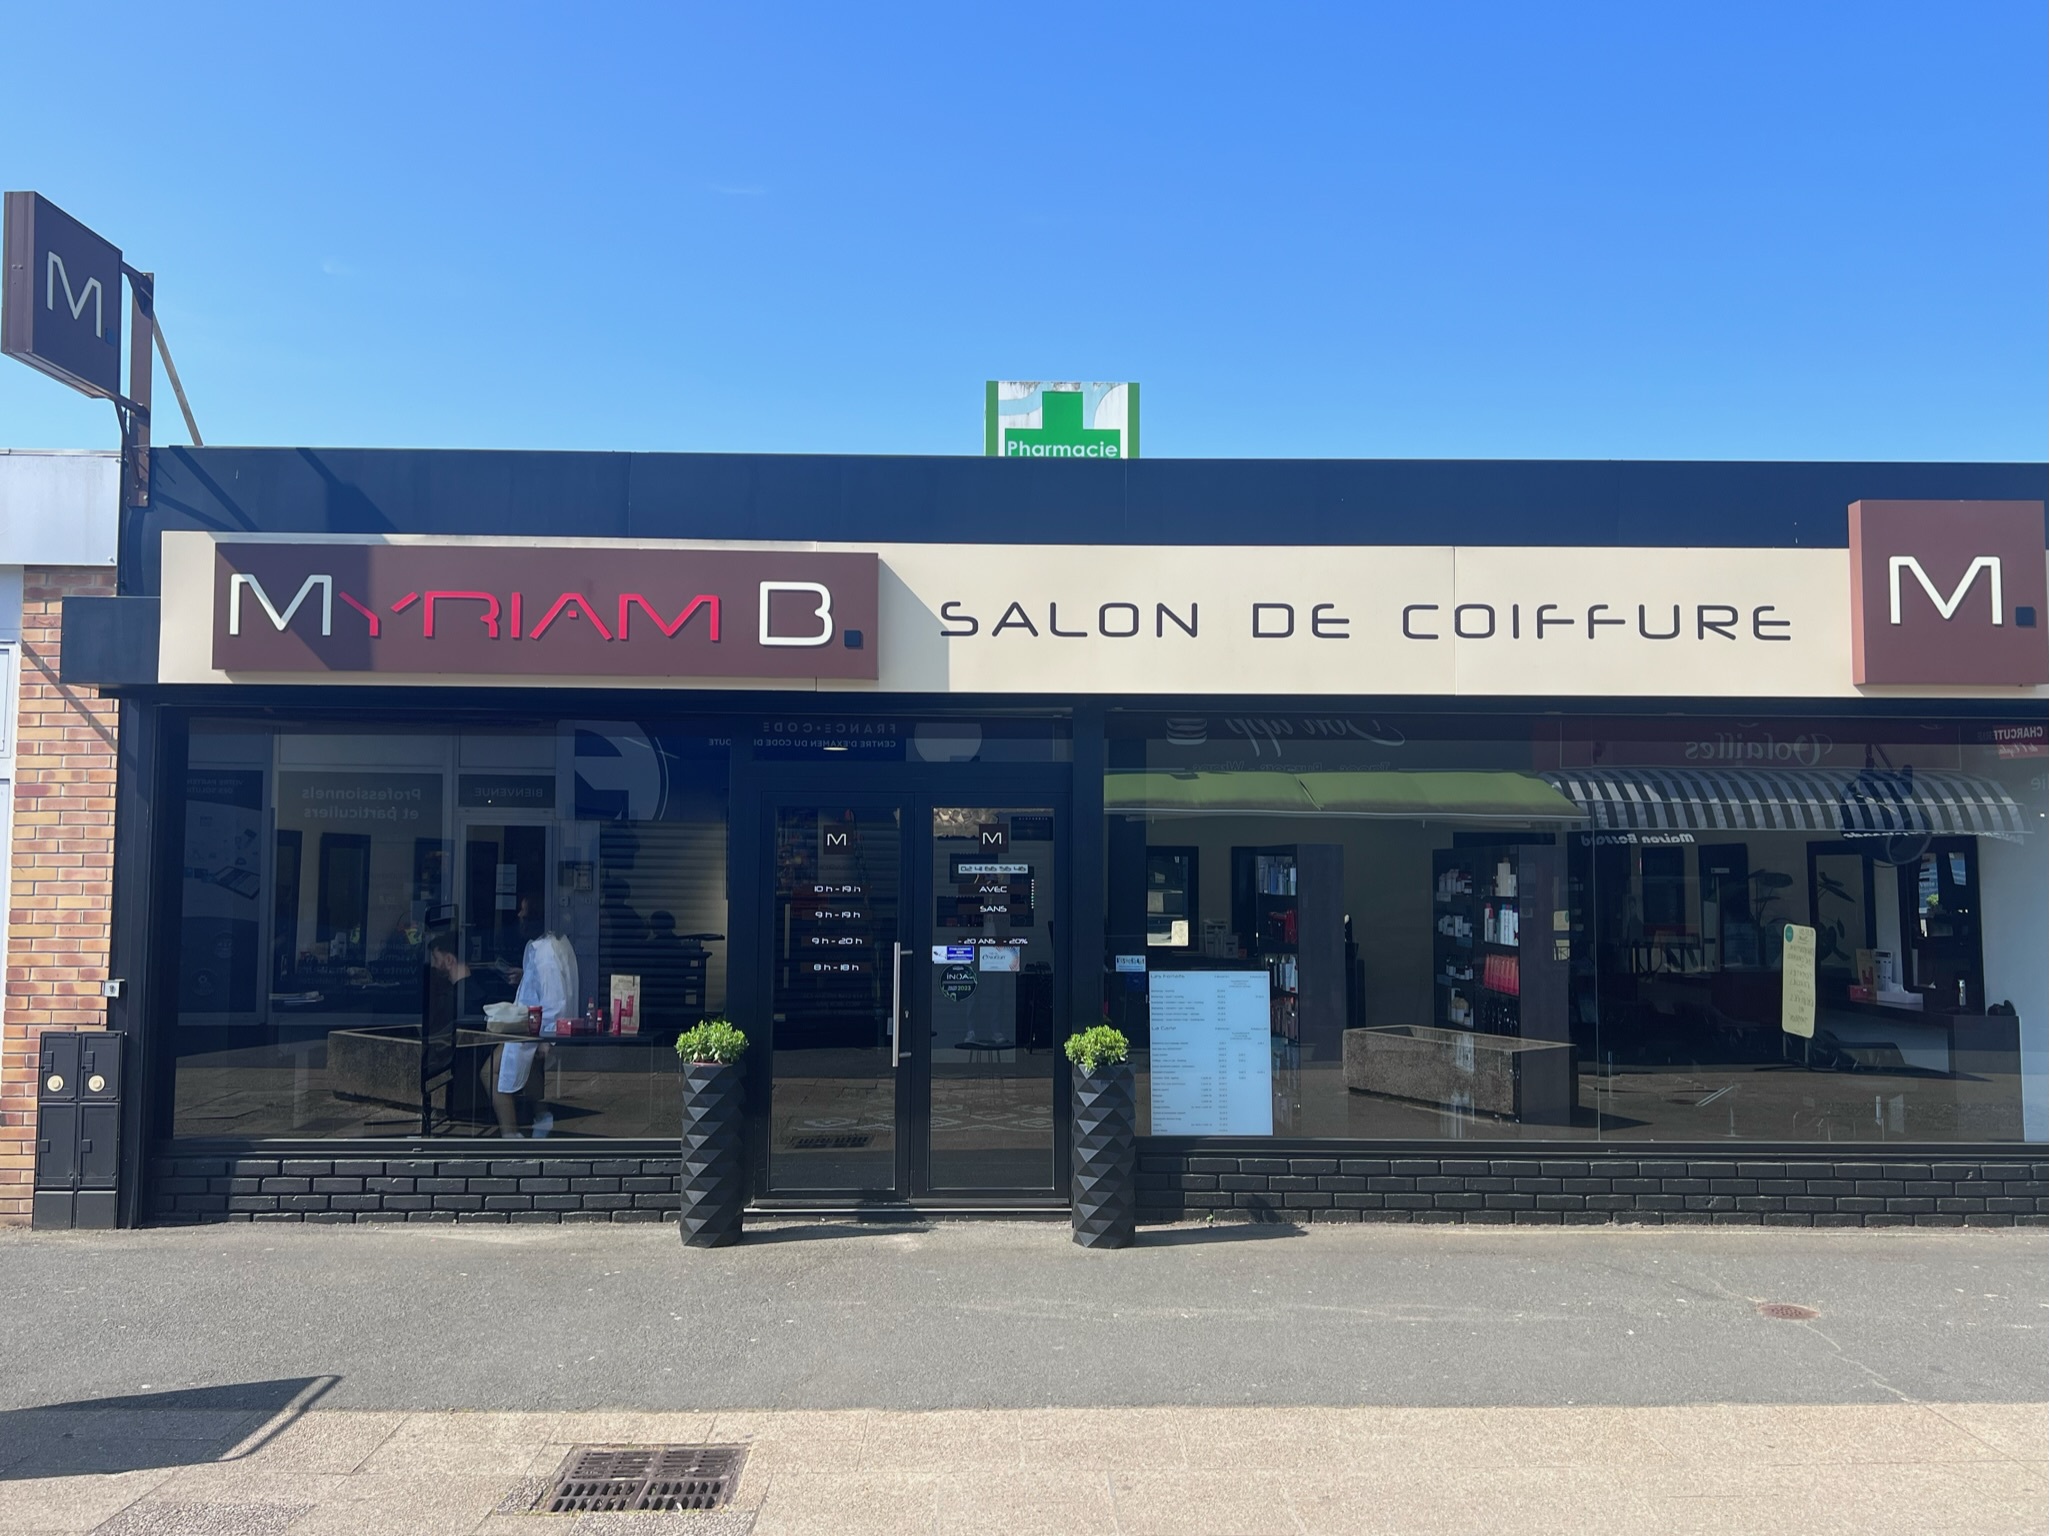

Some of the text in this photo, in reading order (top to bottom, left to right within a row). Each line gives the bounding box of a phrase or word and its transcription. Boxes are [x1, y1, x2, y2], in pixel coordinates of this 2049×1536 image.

[1007, 440, 1118, 457] Pharmacie
[229, 573, 720, 641] MYRIAM
[940, 601, 1792, 641] SALON DE COIFFURE
[813, 885, 823, 893] 10
[825, 885, 832, 893] h
[842, 885, 852, 893] 19
[853, 885, 861, 893] h
[978, 885, 1008, 893] AVEC
[979, 905, 1008, 913] SANS
[814, 911, 822, 919] 9
[824, 911, 832, 919] h
[841, 911, 851, 919] 19
[853, 911, 861, 919] h
[811, 937, 819, 945] 9
[821, 937, 829, 945] h
[838, 937, 853, 945] 20
[855, 937, 863, 945] h
[963, 937, 977, 945] 20
[977, 937, 996, 945] ANS
[1008, 937, 1029, 945] 20%
[824, 963, 831, 972] h
[851, 963, 860, 972] h
